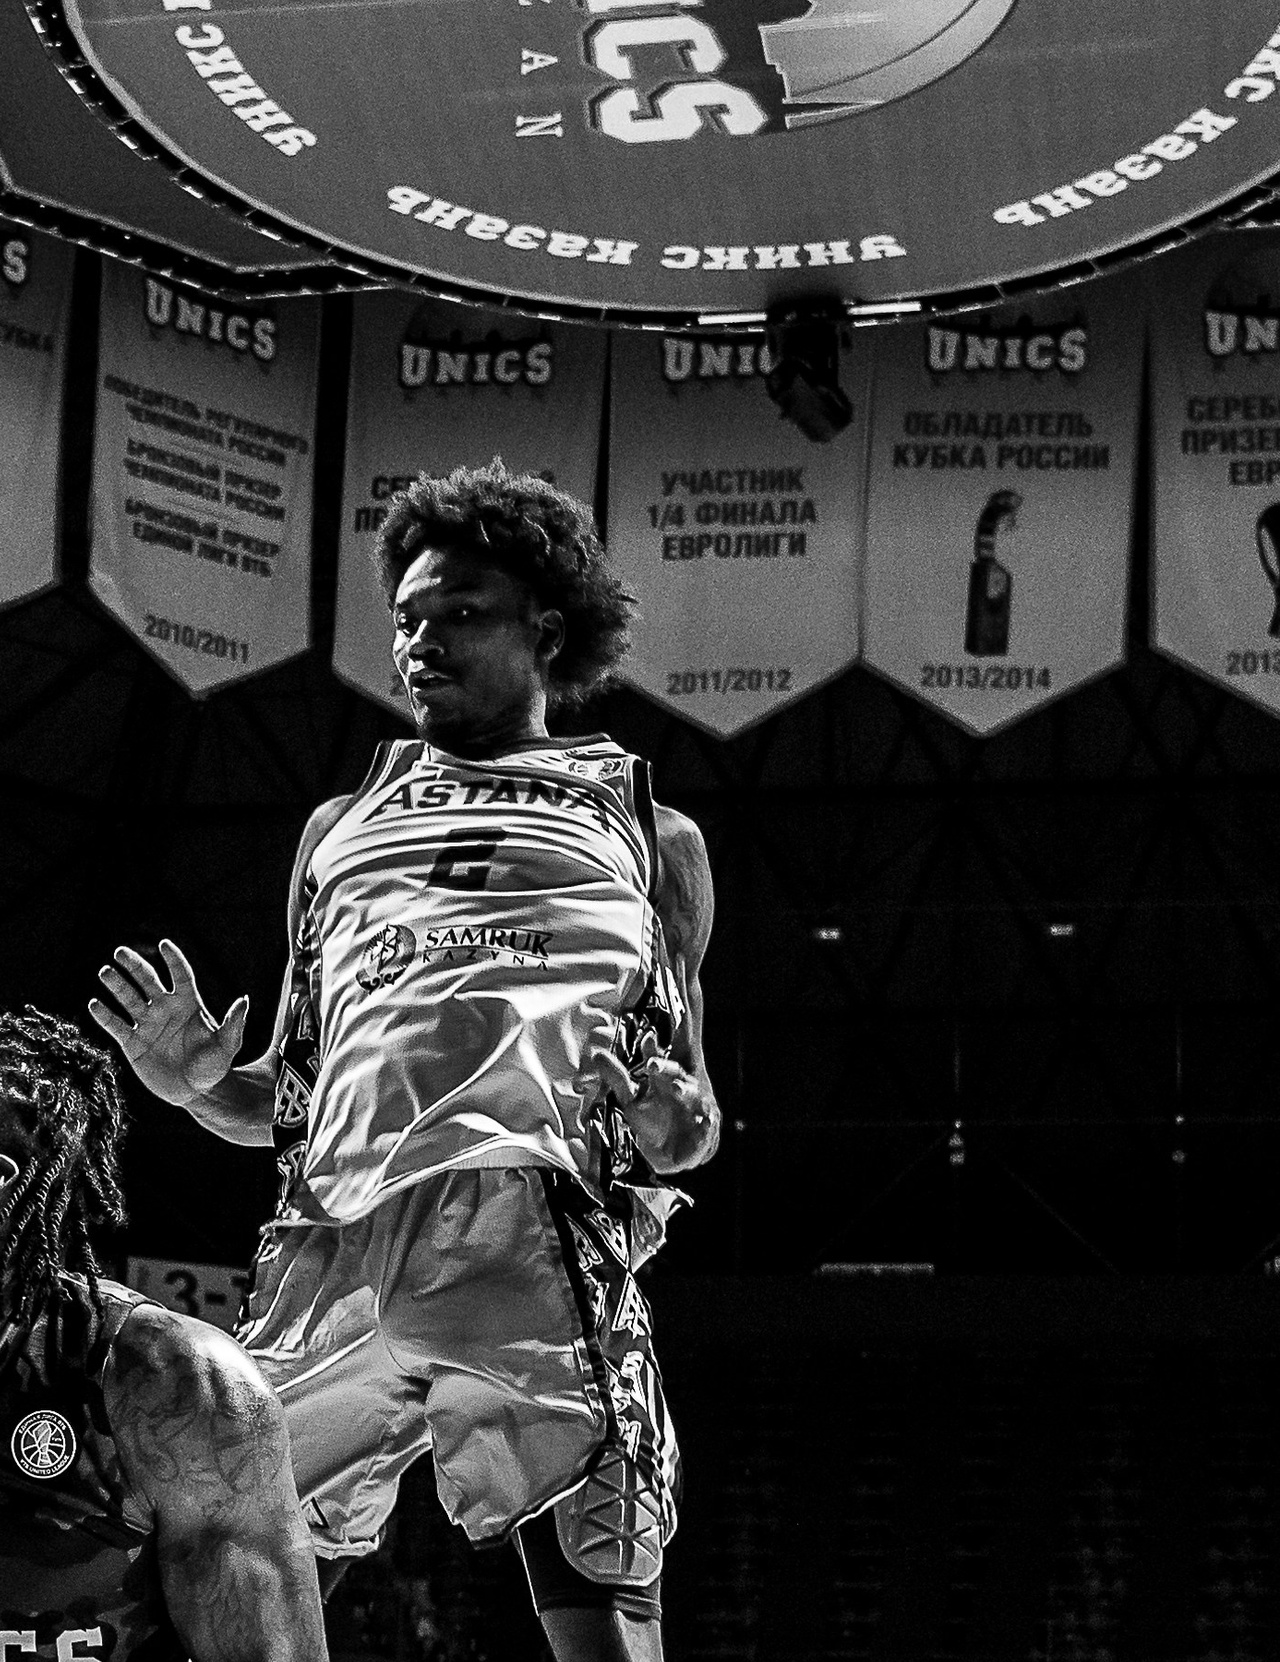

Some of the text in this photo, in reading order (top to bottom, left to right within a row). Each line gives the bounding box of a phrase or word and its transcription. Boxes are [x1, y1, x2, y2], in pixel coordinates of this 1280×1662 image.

[585, 0, 767, 143] CS
[145, 277, 277, 361] UNICS
[400, 343, 555, 387] UNICS
[663, 338, 773, 382] UNI
[927, 327, 1088, 373] UNICS
[903, 411, 1094, 438] ОБЛАДАТЕЛЬ
[893, 444, 1111, 471] КУБКА РОССИИ
[660, 467, 805, 497] УЧАСТНИК
[648, 499, 818, 528] 1/4 ФИНАЛА
[661, 532, 808, 562] ЕВРОЛИГИ
[142, 613, 250, 664] 2010/2011
[665, 668, 792, 696] 2011/2012
[920, 665, 1053, 691] 2013/2014
[425, 926, 554, 957] SAMRUK
